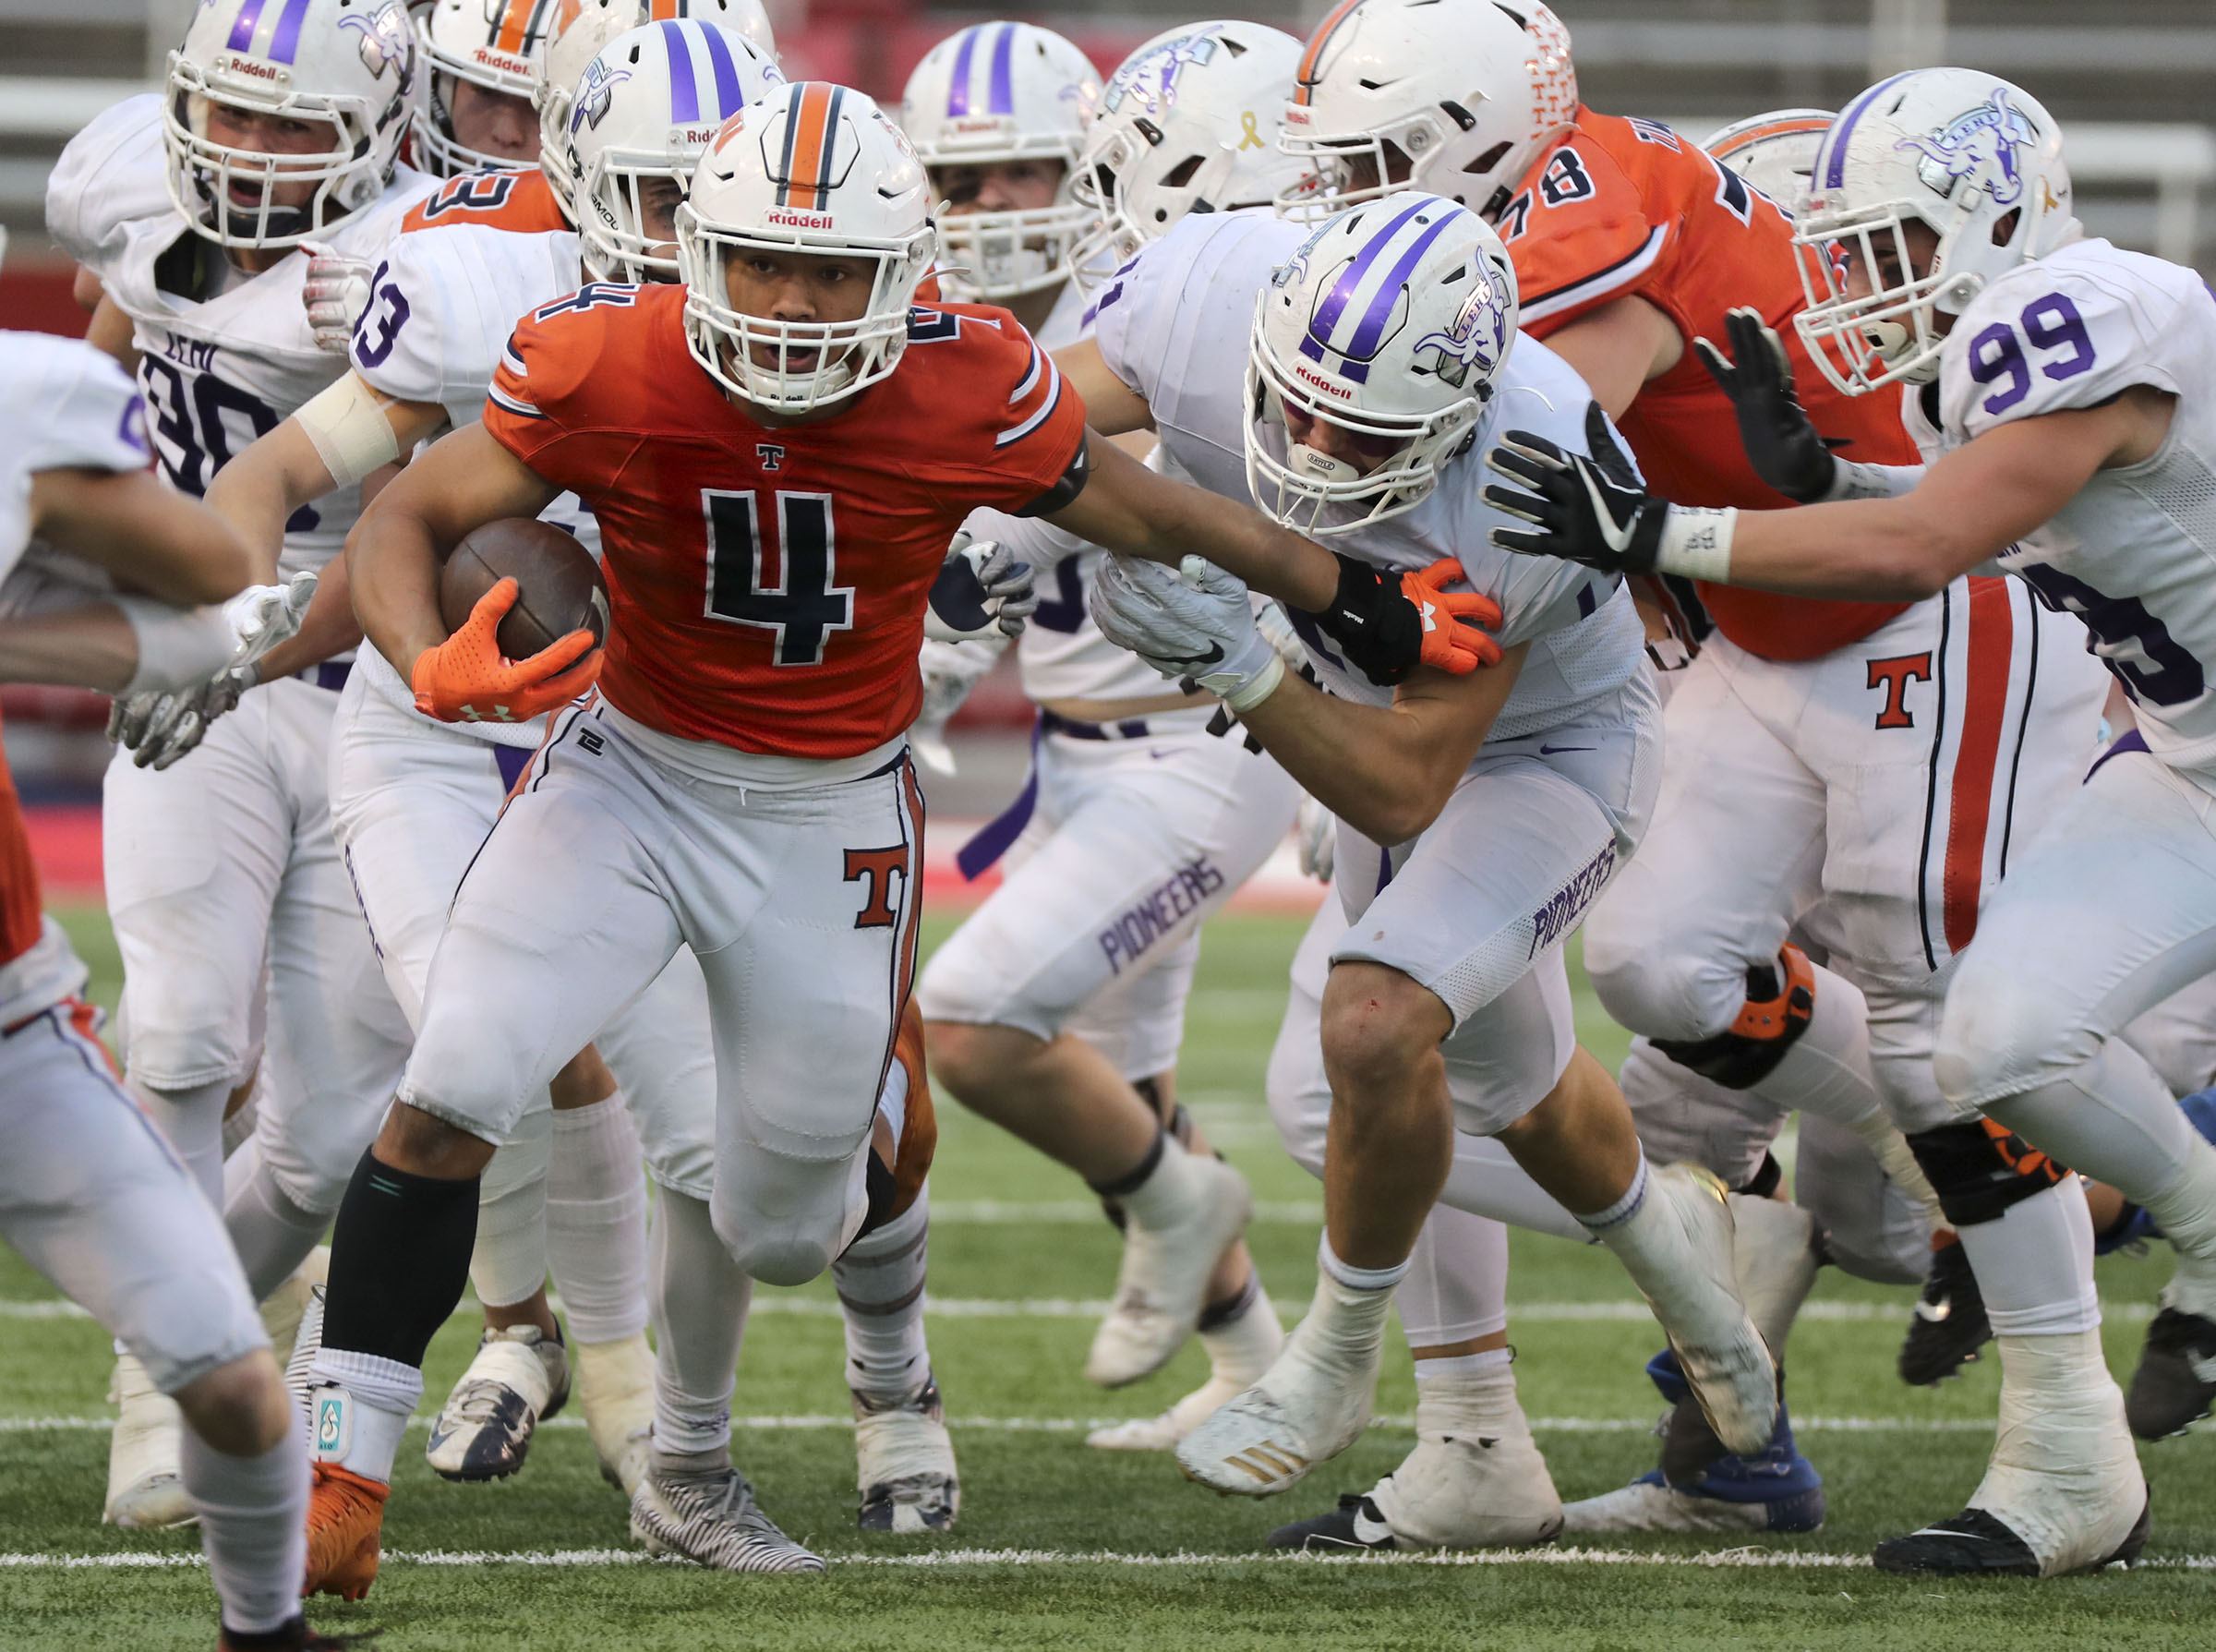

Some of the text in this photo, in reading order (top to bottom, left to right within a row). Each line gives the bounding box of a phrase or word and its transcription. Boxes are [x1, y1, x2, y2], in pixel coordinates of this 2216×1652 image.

[231, 57, 277, 80] Riddell
[475, 49, 532, 77] Riddel
[768, 212, 833, 230] Riddell
[535, 281, 642, 324] 4
[1460, 292, 1489, 333] LEHI
[1969, 292, 2096, 416] 99
[769, 392, 804, 402] Ridell
[1295, 366, 1352, 400] Riddell
[756, 443, 786, 471] T
[700, 488, 856, 667] 4
[1865, 649, 1933, 730] T
[842, 841, 909, 929] T
[1528, 837, 1618, 961] PIONEERS
[1099, 855, 1225, 976] PIONEERS
